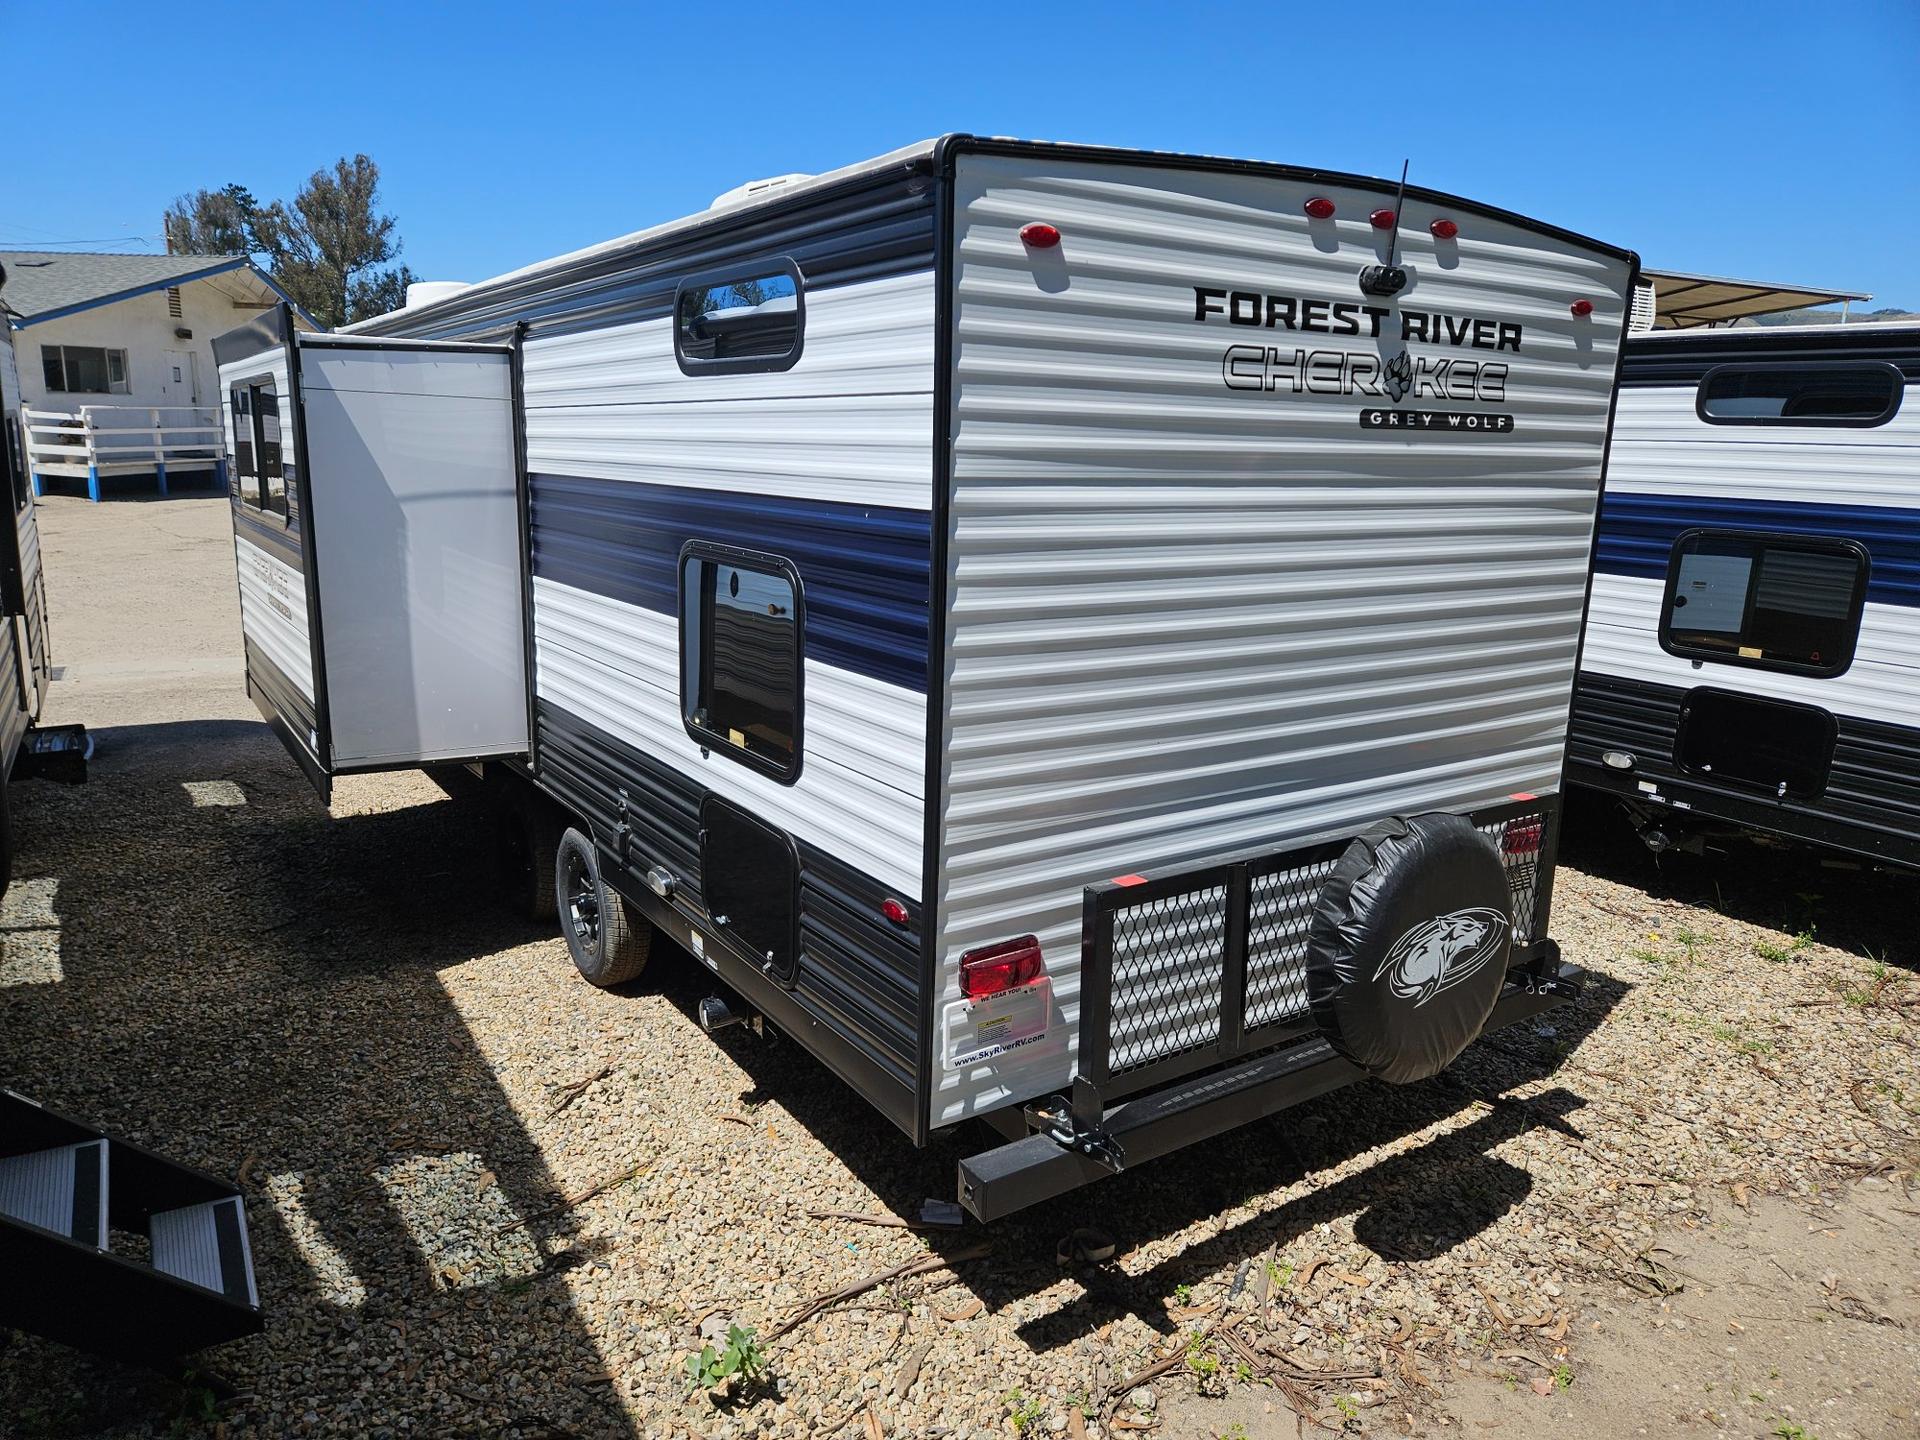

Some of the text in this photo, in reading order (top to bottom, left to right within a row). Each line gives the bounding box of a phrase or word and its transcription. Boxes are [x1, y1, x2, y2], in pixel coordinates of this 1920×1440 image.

[1193, 286, 1523, 352] FOREST RIVER
[1370, 412, 1506, 429] GREY WOLF
[954, 1033, 1045, 1067] www.SkyRiverRV.com
